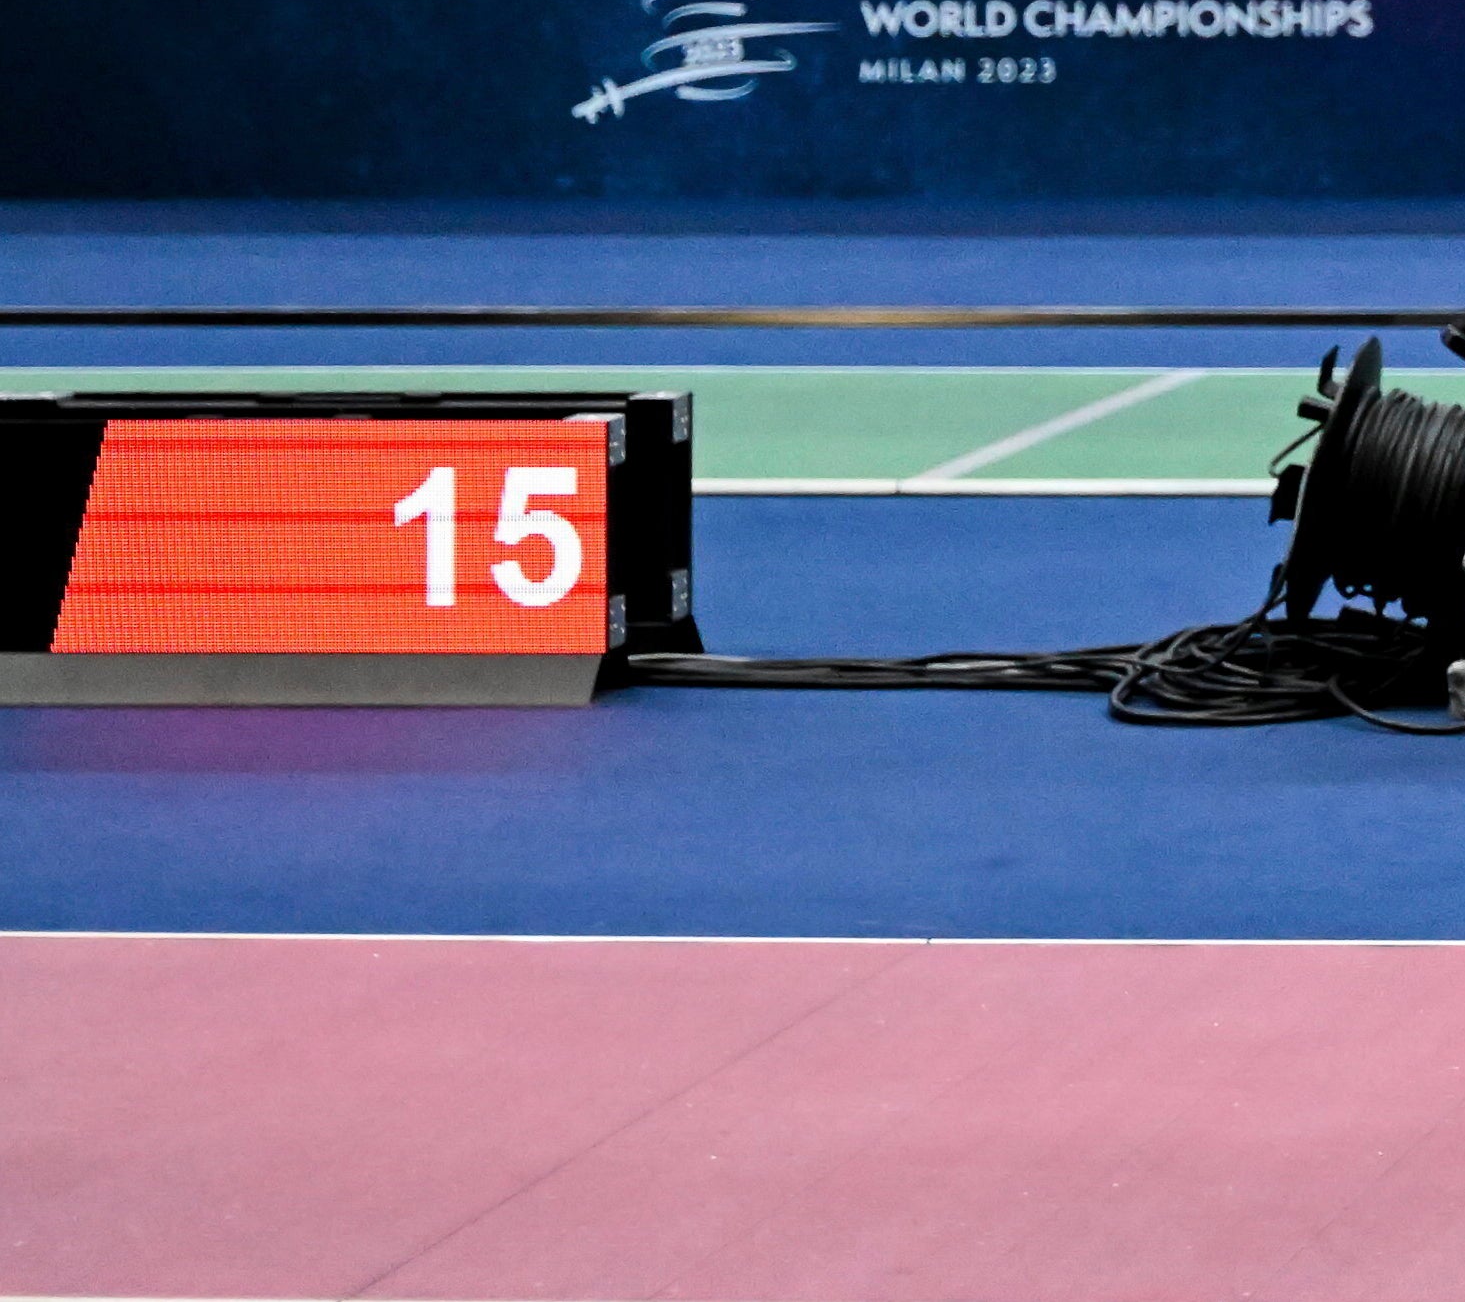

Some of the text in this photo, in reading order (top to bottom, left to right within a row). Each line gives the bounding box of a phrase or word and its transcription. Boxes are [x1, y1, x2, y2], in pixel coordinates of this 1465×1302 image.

[860, 0, 1018, 39] WORLD
[858, 56, 1058, 85] MILAN 2023
[393, 466, 583, 607] 15
